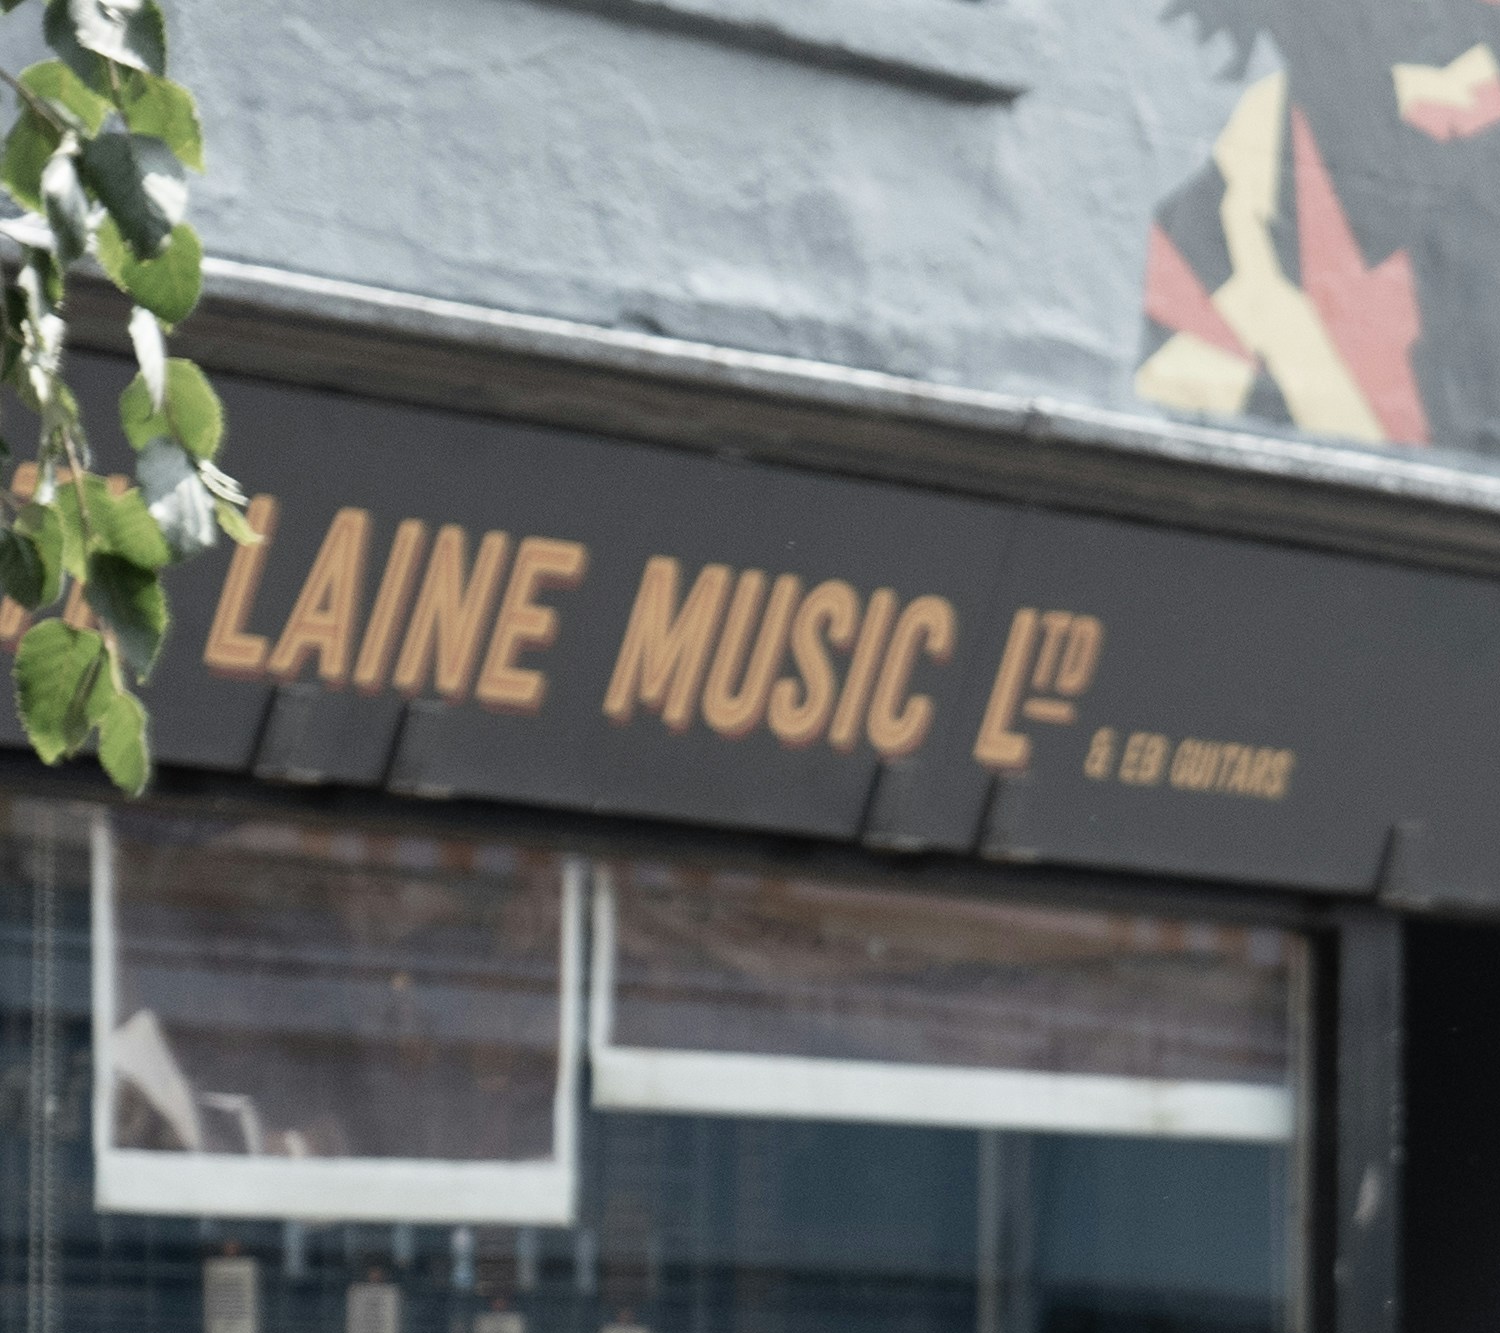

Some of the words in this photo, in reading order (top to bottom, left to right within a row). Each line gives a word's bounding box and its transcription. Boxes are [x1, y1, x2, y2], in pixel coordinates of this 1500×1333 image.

[202, 494, 588, 716] LAINE
[602, 555, 956, 758] MUSIC
[1168, 737, 1297, 799] GUITARS
